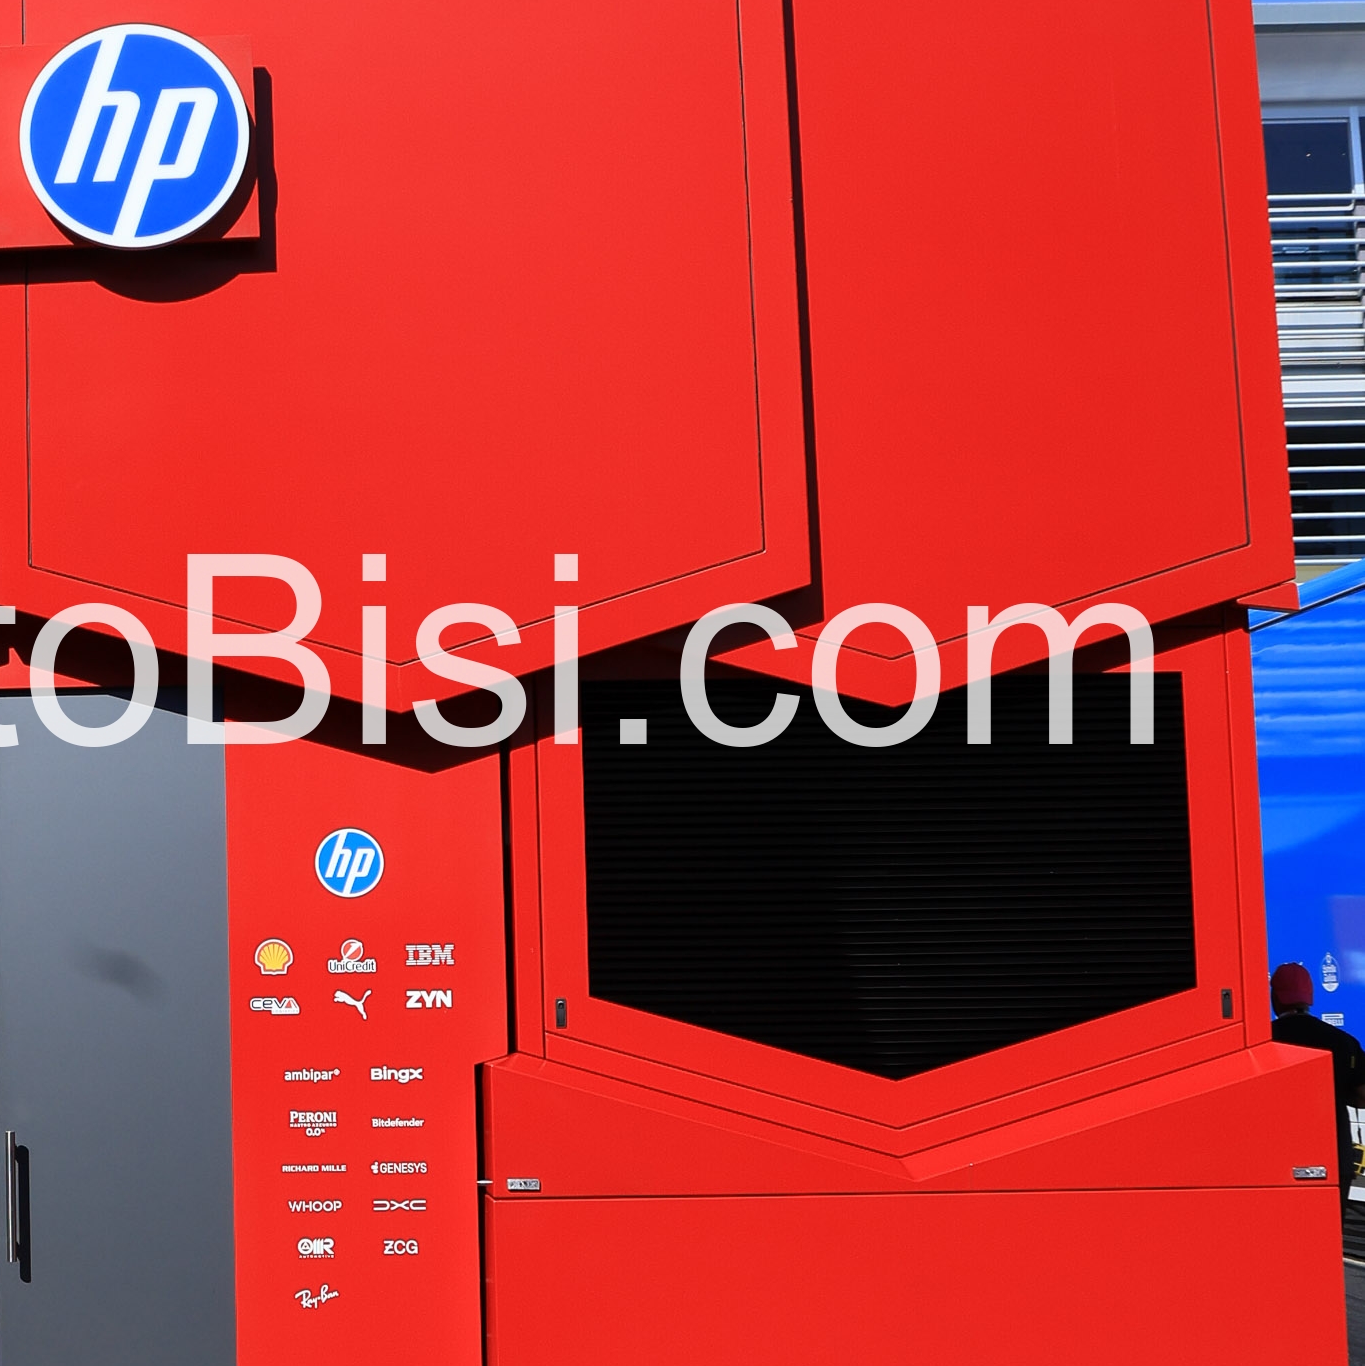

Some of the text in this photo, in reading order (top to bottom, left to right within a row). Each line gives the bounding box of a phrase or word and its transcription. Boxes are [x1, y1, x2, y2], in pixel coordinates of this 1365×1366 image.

[54, 33, 218, 237] hp
[324, 831, 376, 895] hp
[406, 945, 454, 965] IBM
[329, 960, 375, 971] UniCredit
[406, 990, 452, 1008] ZYN
[290, 1110, 337, 1123] PERONI
[372, 1118, 424, 1127] Bitdefender
[380, 1163, 427, 1173] GENESYS
[289, 1201, 342, 1212] WHOOP
[384, 1240, 418, 1254] ZCG
